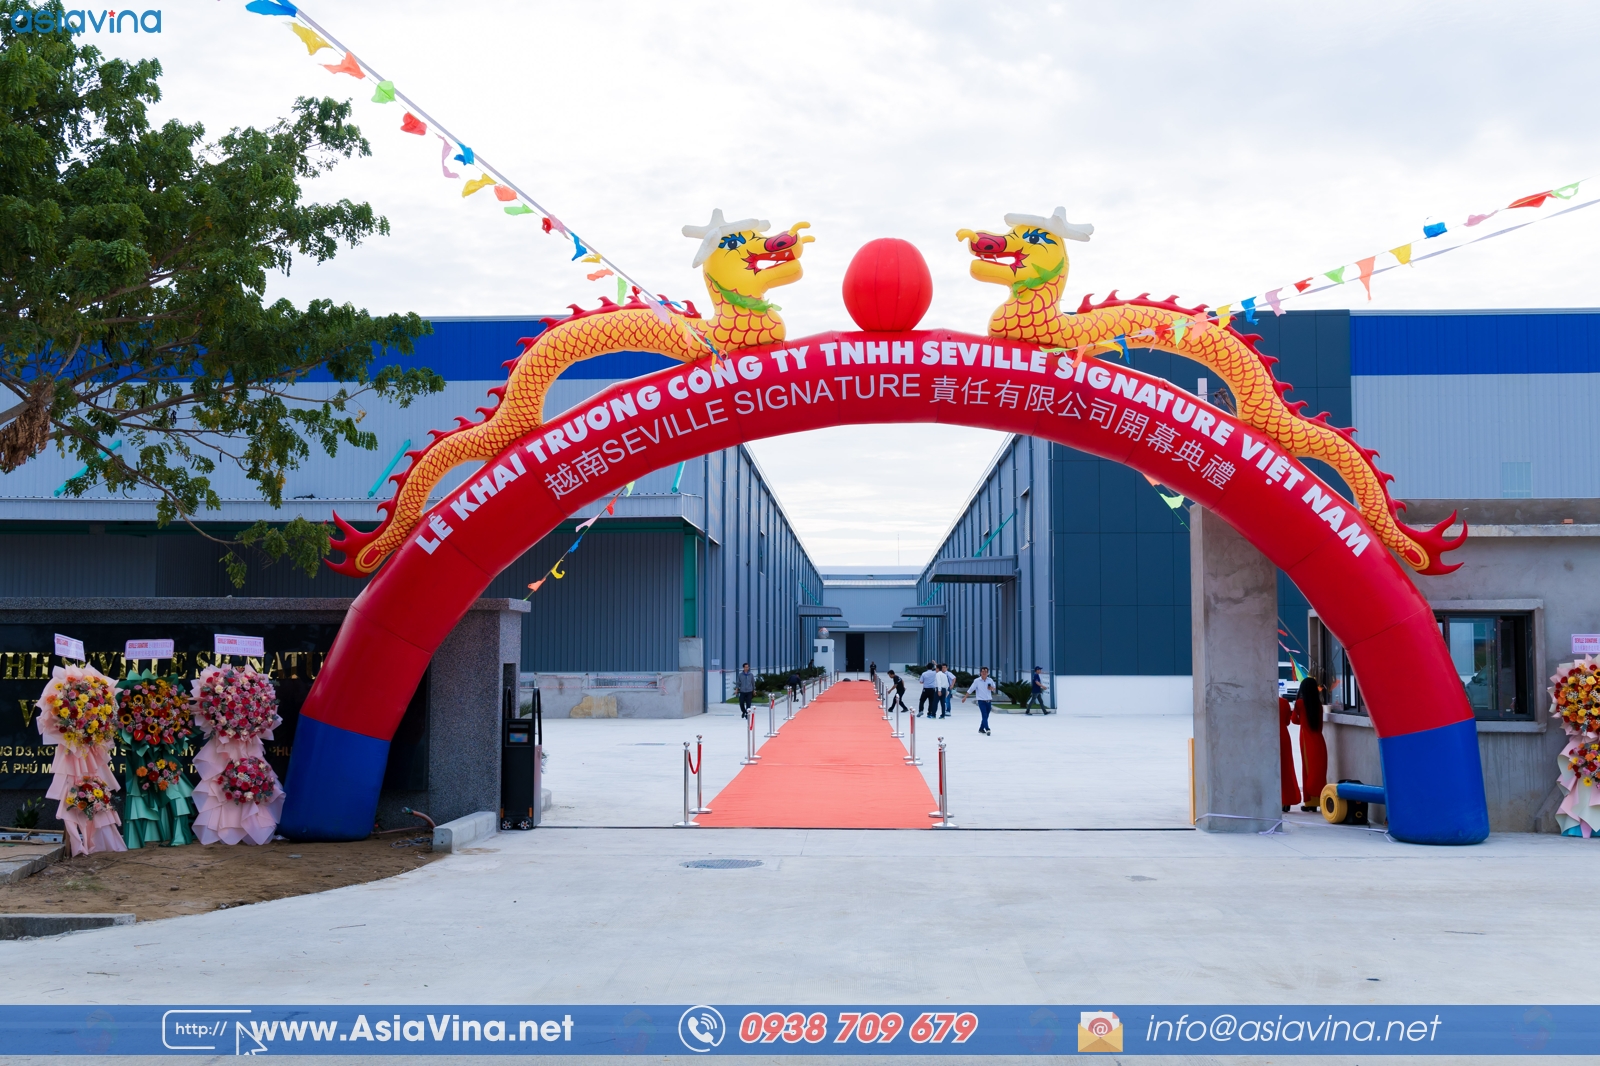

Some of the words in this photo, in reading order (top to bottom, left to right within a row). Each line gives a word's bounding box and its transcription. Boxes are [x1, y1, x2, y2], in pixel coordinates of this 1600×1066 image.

[735, 374, 921, 415] SIGNATURE
[929, 375, 1236, 490] 責任有限公司開幕典禮
[415, 512, 454, 554] LỄ
[450, 453, 527, 521] KHAI
[525, 386, 662, 463] TRƯƠNG
[667, 356, 763, 399] CÔNG
[770, 343, 810, 373] TY
[820, 341, 915, 366] TNHH
[921, 341, 1048, 374] SEVILLE
[1054, 356, 1235, 447] SIGNATURE
[1241, 433, 1305, 492] VIỆT
[1302, 484, 1371, 557] NAM
[0, 652, 52, 680] HH
[15, 745, 35, 758] D3,
[13, 760, 38, 774] PHÚ
